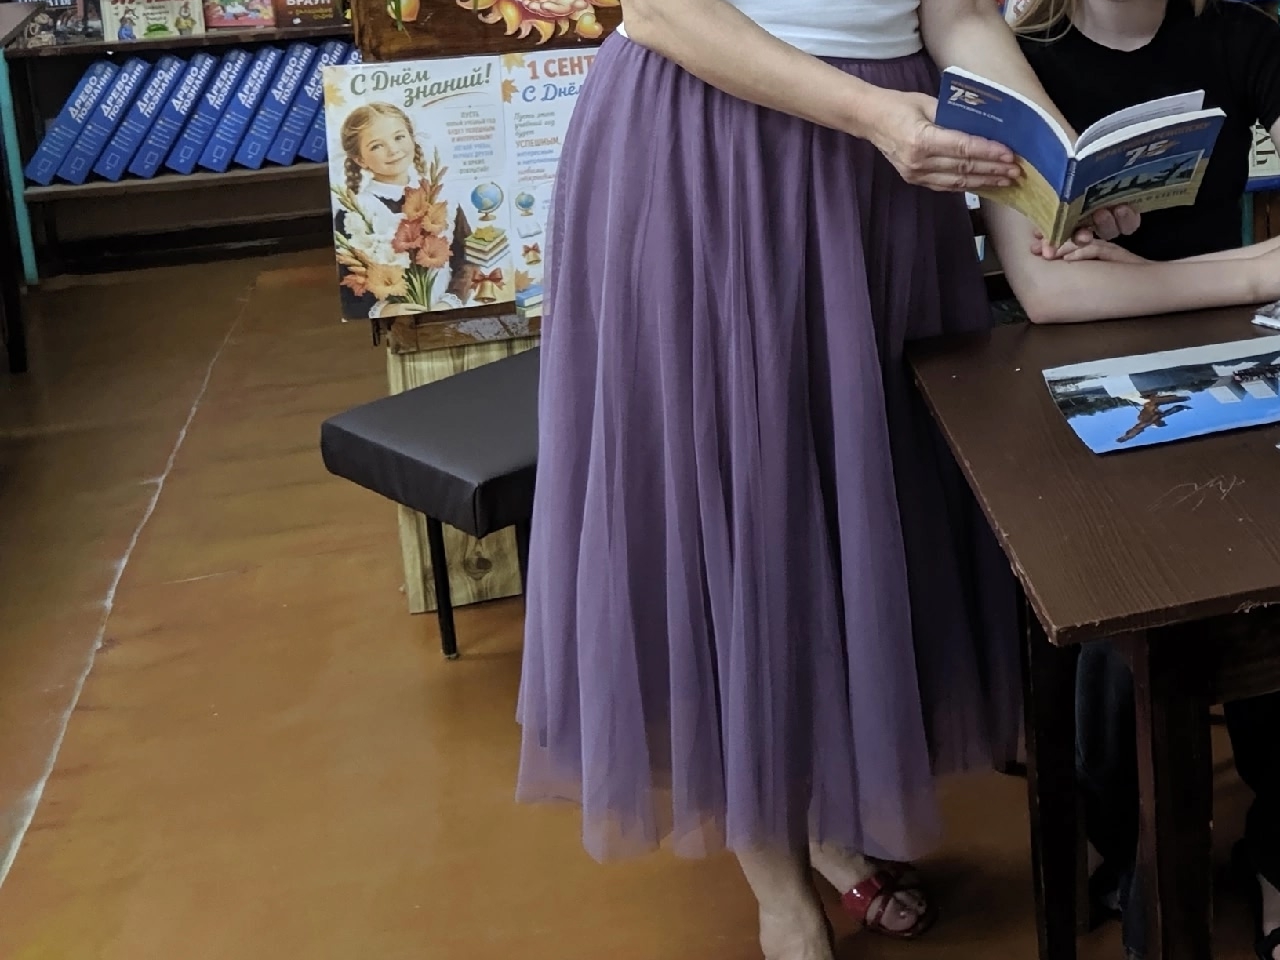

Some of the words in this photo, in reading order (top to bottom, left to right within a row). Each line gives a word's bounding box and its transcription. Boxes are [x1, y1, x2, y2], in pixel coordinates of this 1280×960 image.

[171, 66, 199, 113] ДРЕВО
[205, 61, 234, 106] ДРЕВО
[237, 59, 264, 105] ДРЕВО
[270, 56, 298, 101] ДРЕВО
[350, 73, 367, 96] С
[371, 67, 431, 92] Днём
[403, 62, 493, 108] знаний!
[527, 60, 540, 80] 1
[543, 55, 595, 77] СЕНТ
[68, 76, 98, 119] ДРЕВО
[100, 72, 131, 118] ДРЕВО
[136, 69, 167, 115] ДРЕВО
[522, 85, 537, 103] С
[948, 84, 980, 106] 75
[1123, 139, 1170, 168] 75
